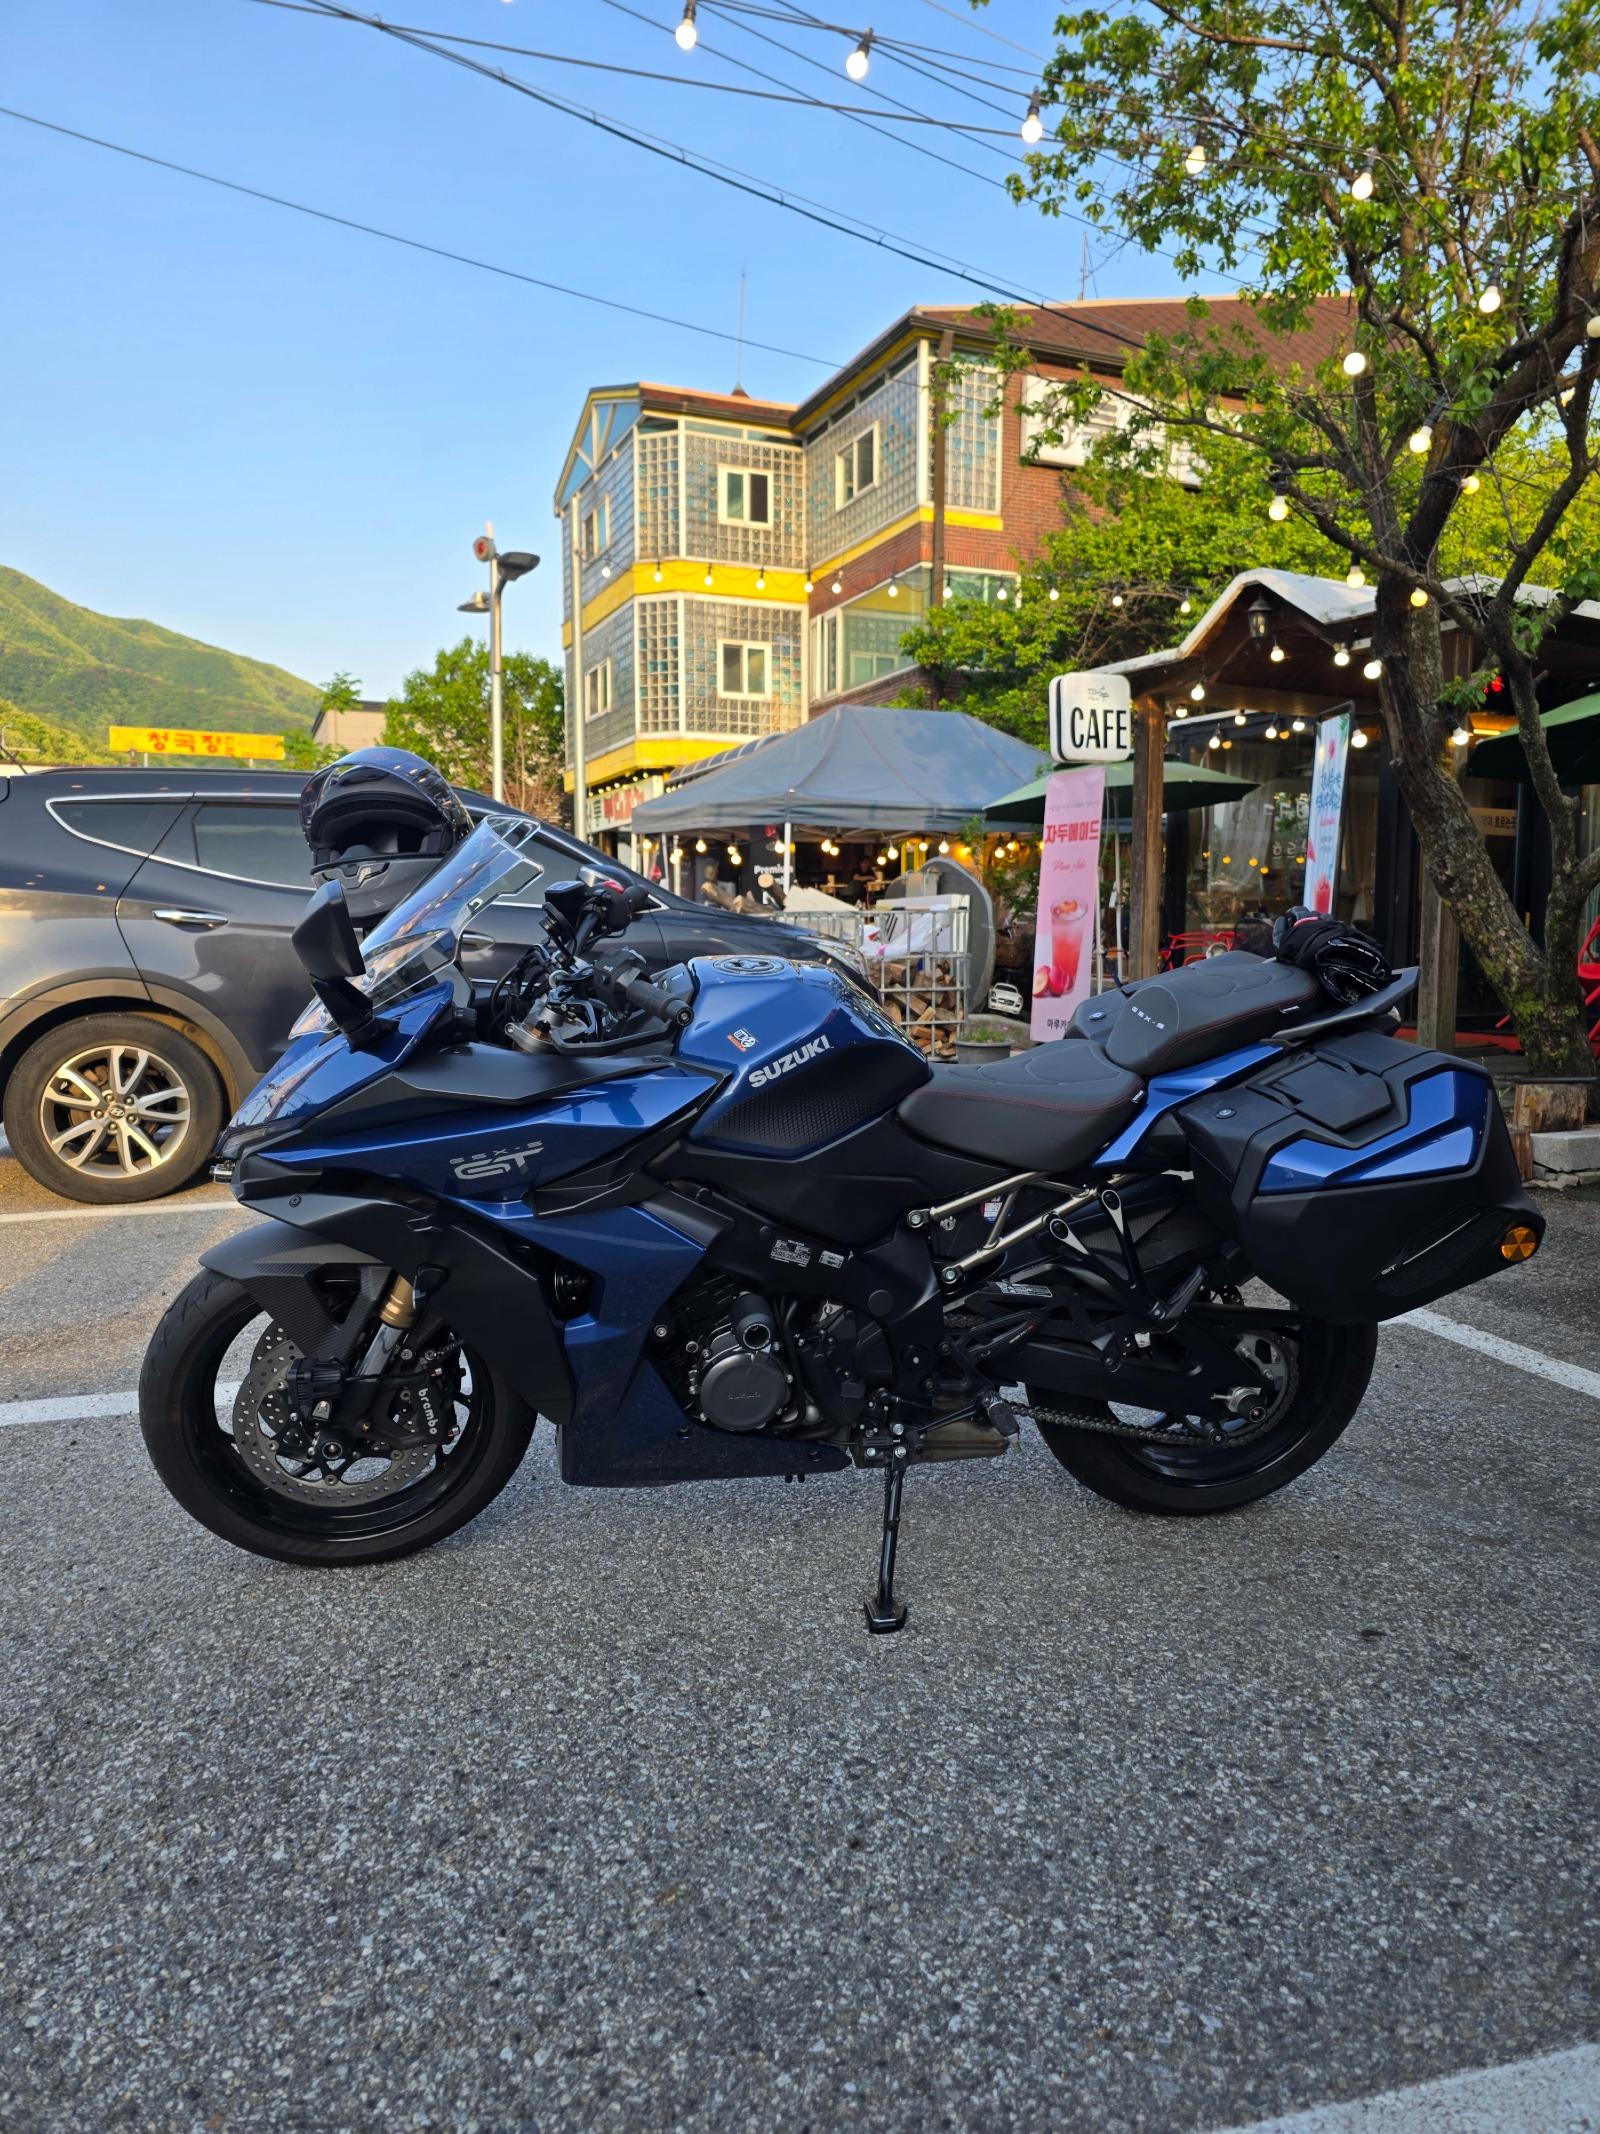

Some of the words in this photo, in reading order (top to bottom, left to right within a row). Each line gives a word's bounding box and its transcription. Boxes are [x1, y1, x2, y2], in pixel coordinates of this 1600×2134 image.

[149, 731, 222, 754] 청국장
[1070, 706, 1127, 749] CAFE
[1044, 820, 1100, 844] 자두에이드
[748, 1034, 832, 1088] SUZUKI
[454, 1147, 545, 1180] GT
[418, 1387, 439, 1435] brembo
